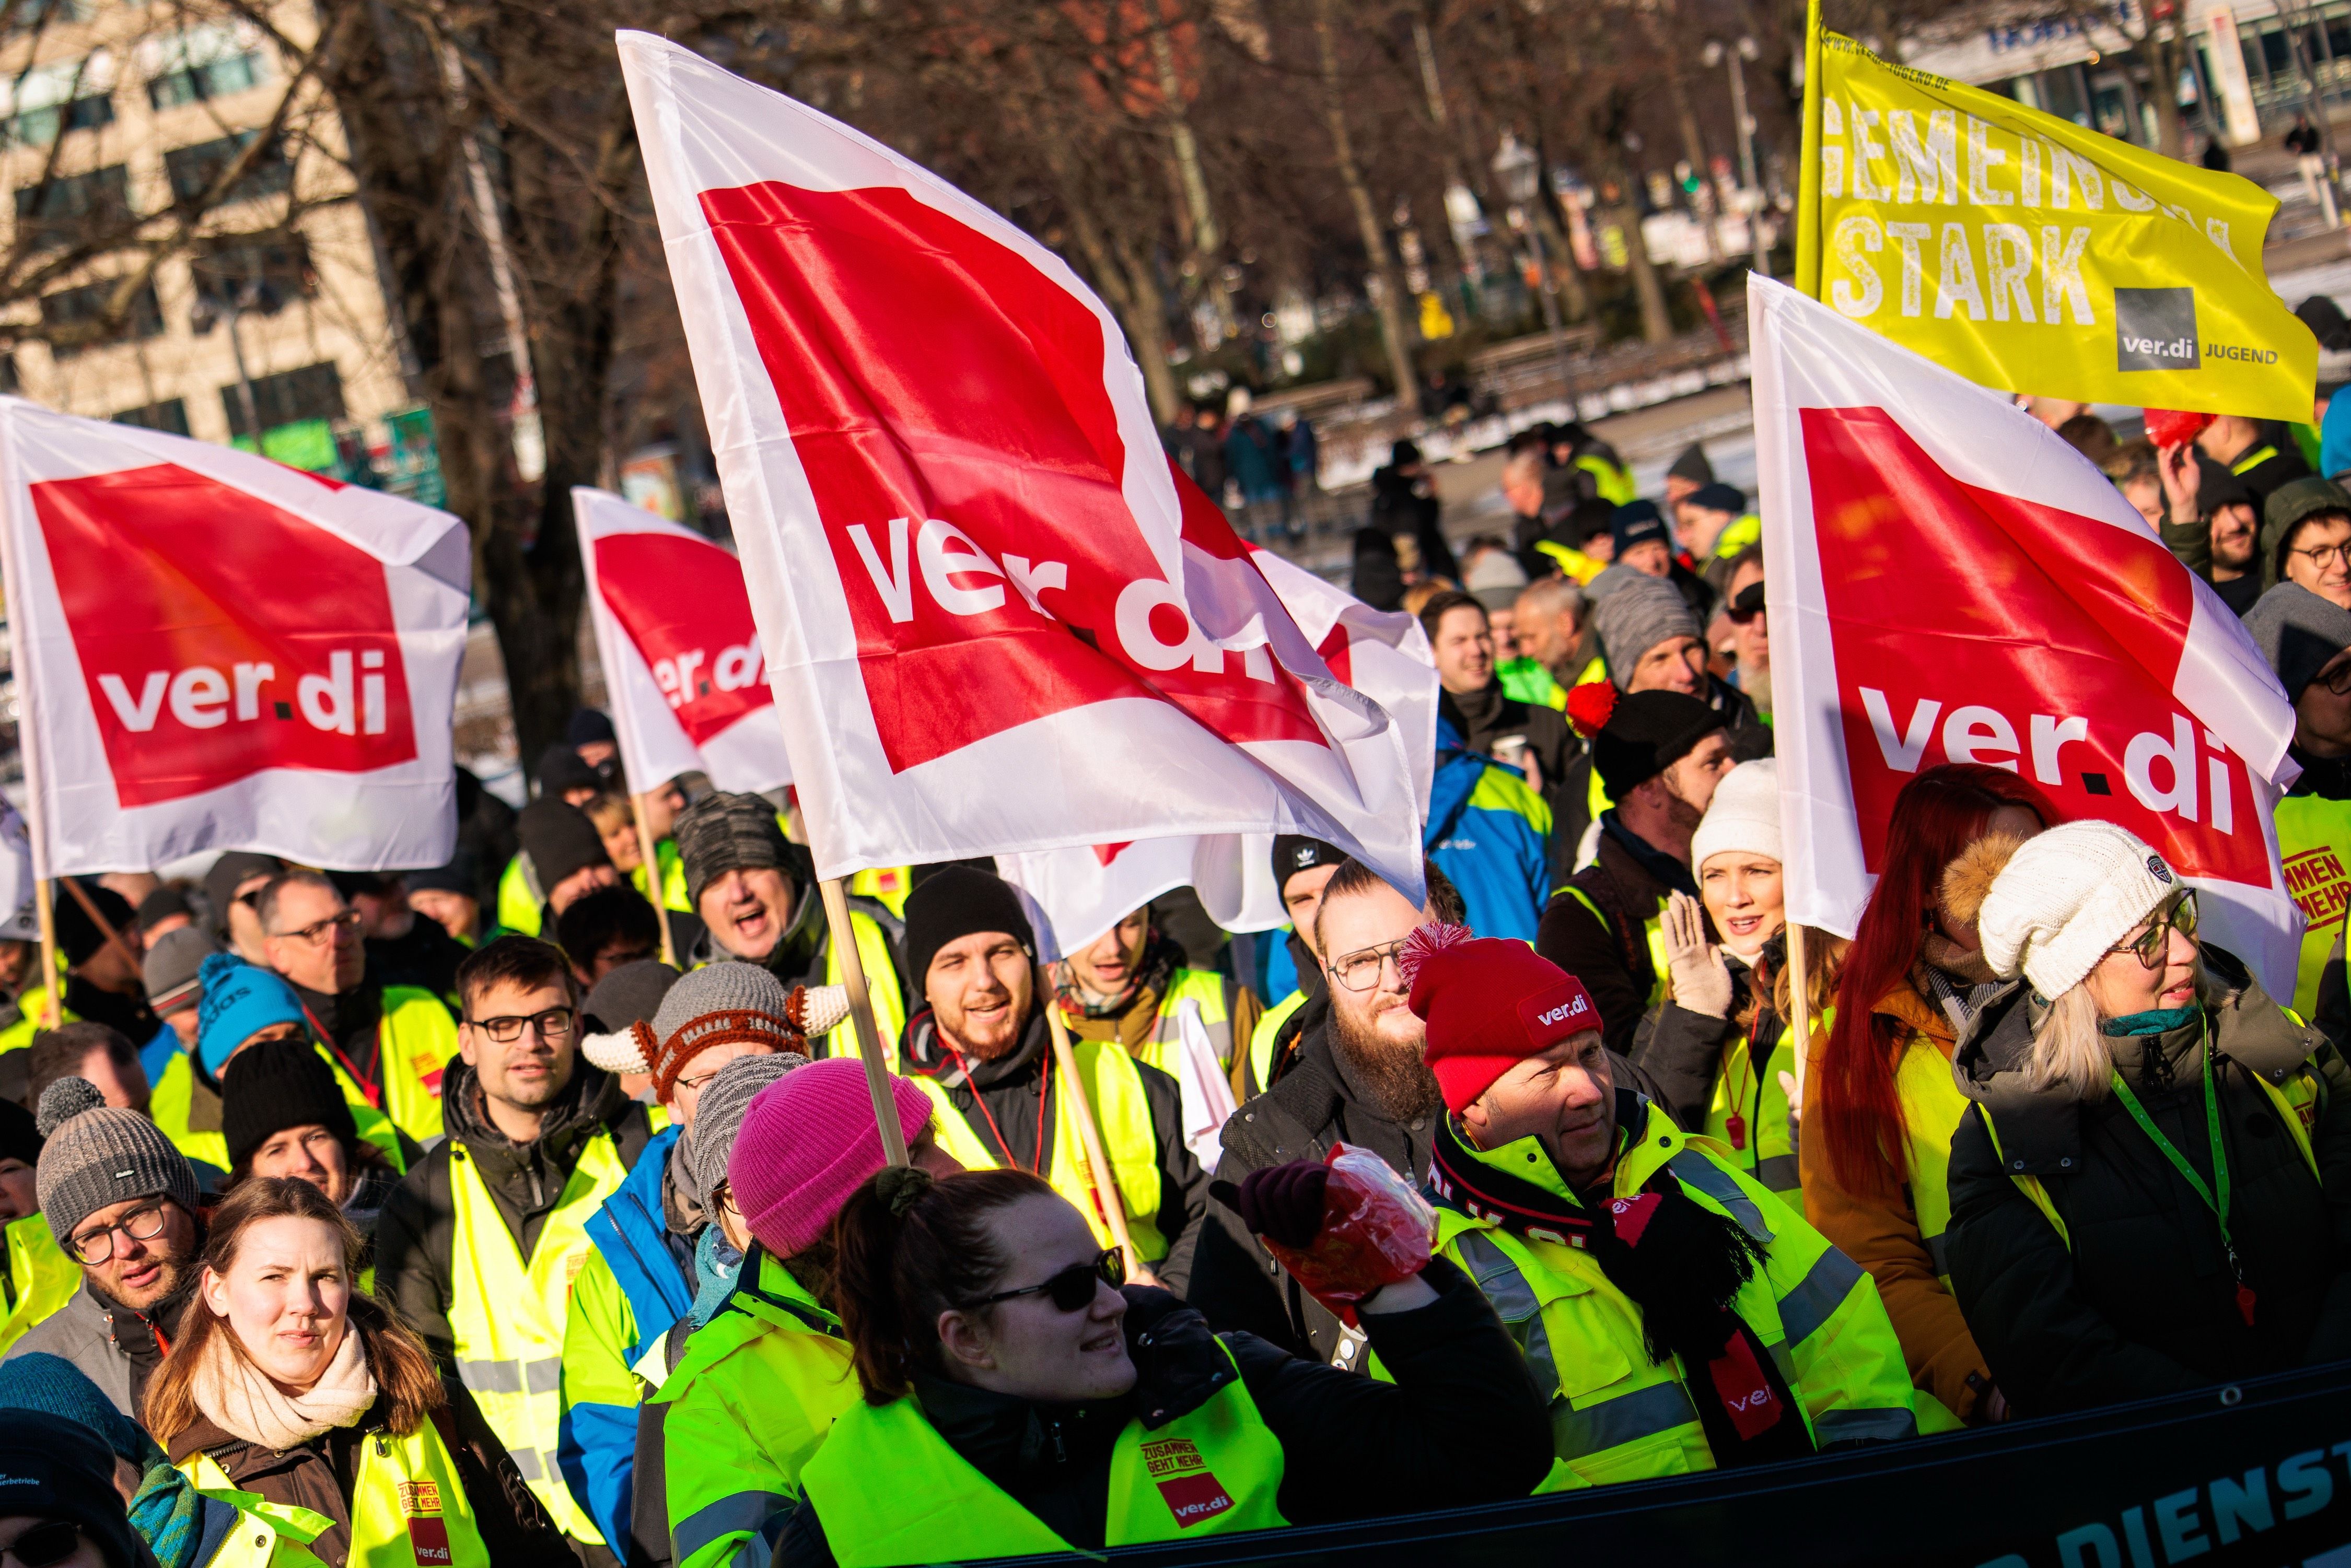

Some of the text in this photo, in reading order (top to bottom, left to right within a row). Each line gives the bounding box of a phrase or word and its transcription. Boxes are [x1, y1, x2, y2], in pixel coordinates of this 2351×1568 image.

[1821, 96, 2248, 274] GEMEIN
[1832, 216, 2095, 325] STARK
[2123, 337, 2278, 365] ver.di JUGEND
[846, 517, 1275, 685] ver.d
[97, 650, 386, 736] ver.di
[1858, 686, 2233, 836] ver.di
[1537, 994, 1588, 1026] ver.di
[1142, 1442, 1199, 1460] ZUSAMMEN
[1147, 1454, 1205, 1473] GEHT MEHR
[399, 1485, 439, 1498] ZUSAMMEN
[421, 1497, 441, 1508] MEHR
[1176, 1495, 1228, 1517] ver.di
[416, 1546, 448, 1560] ver.di
